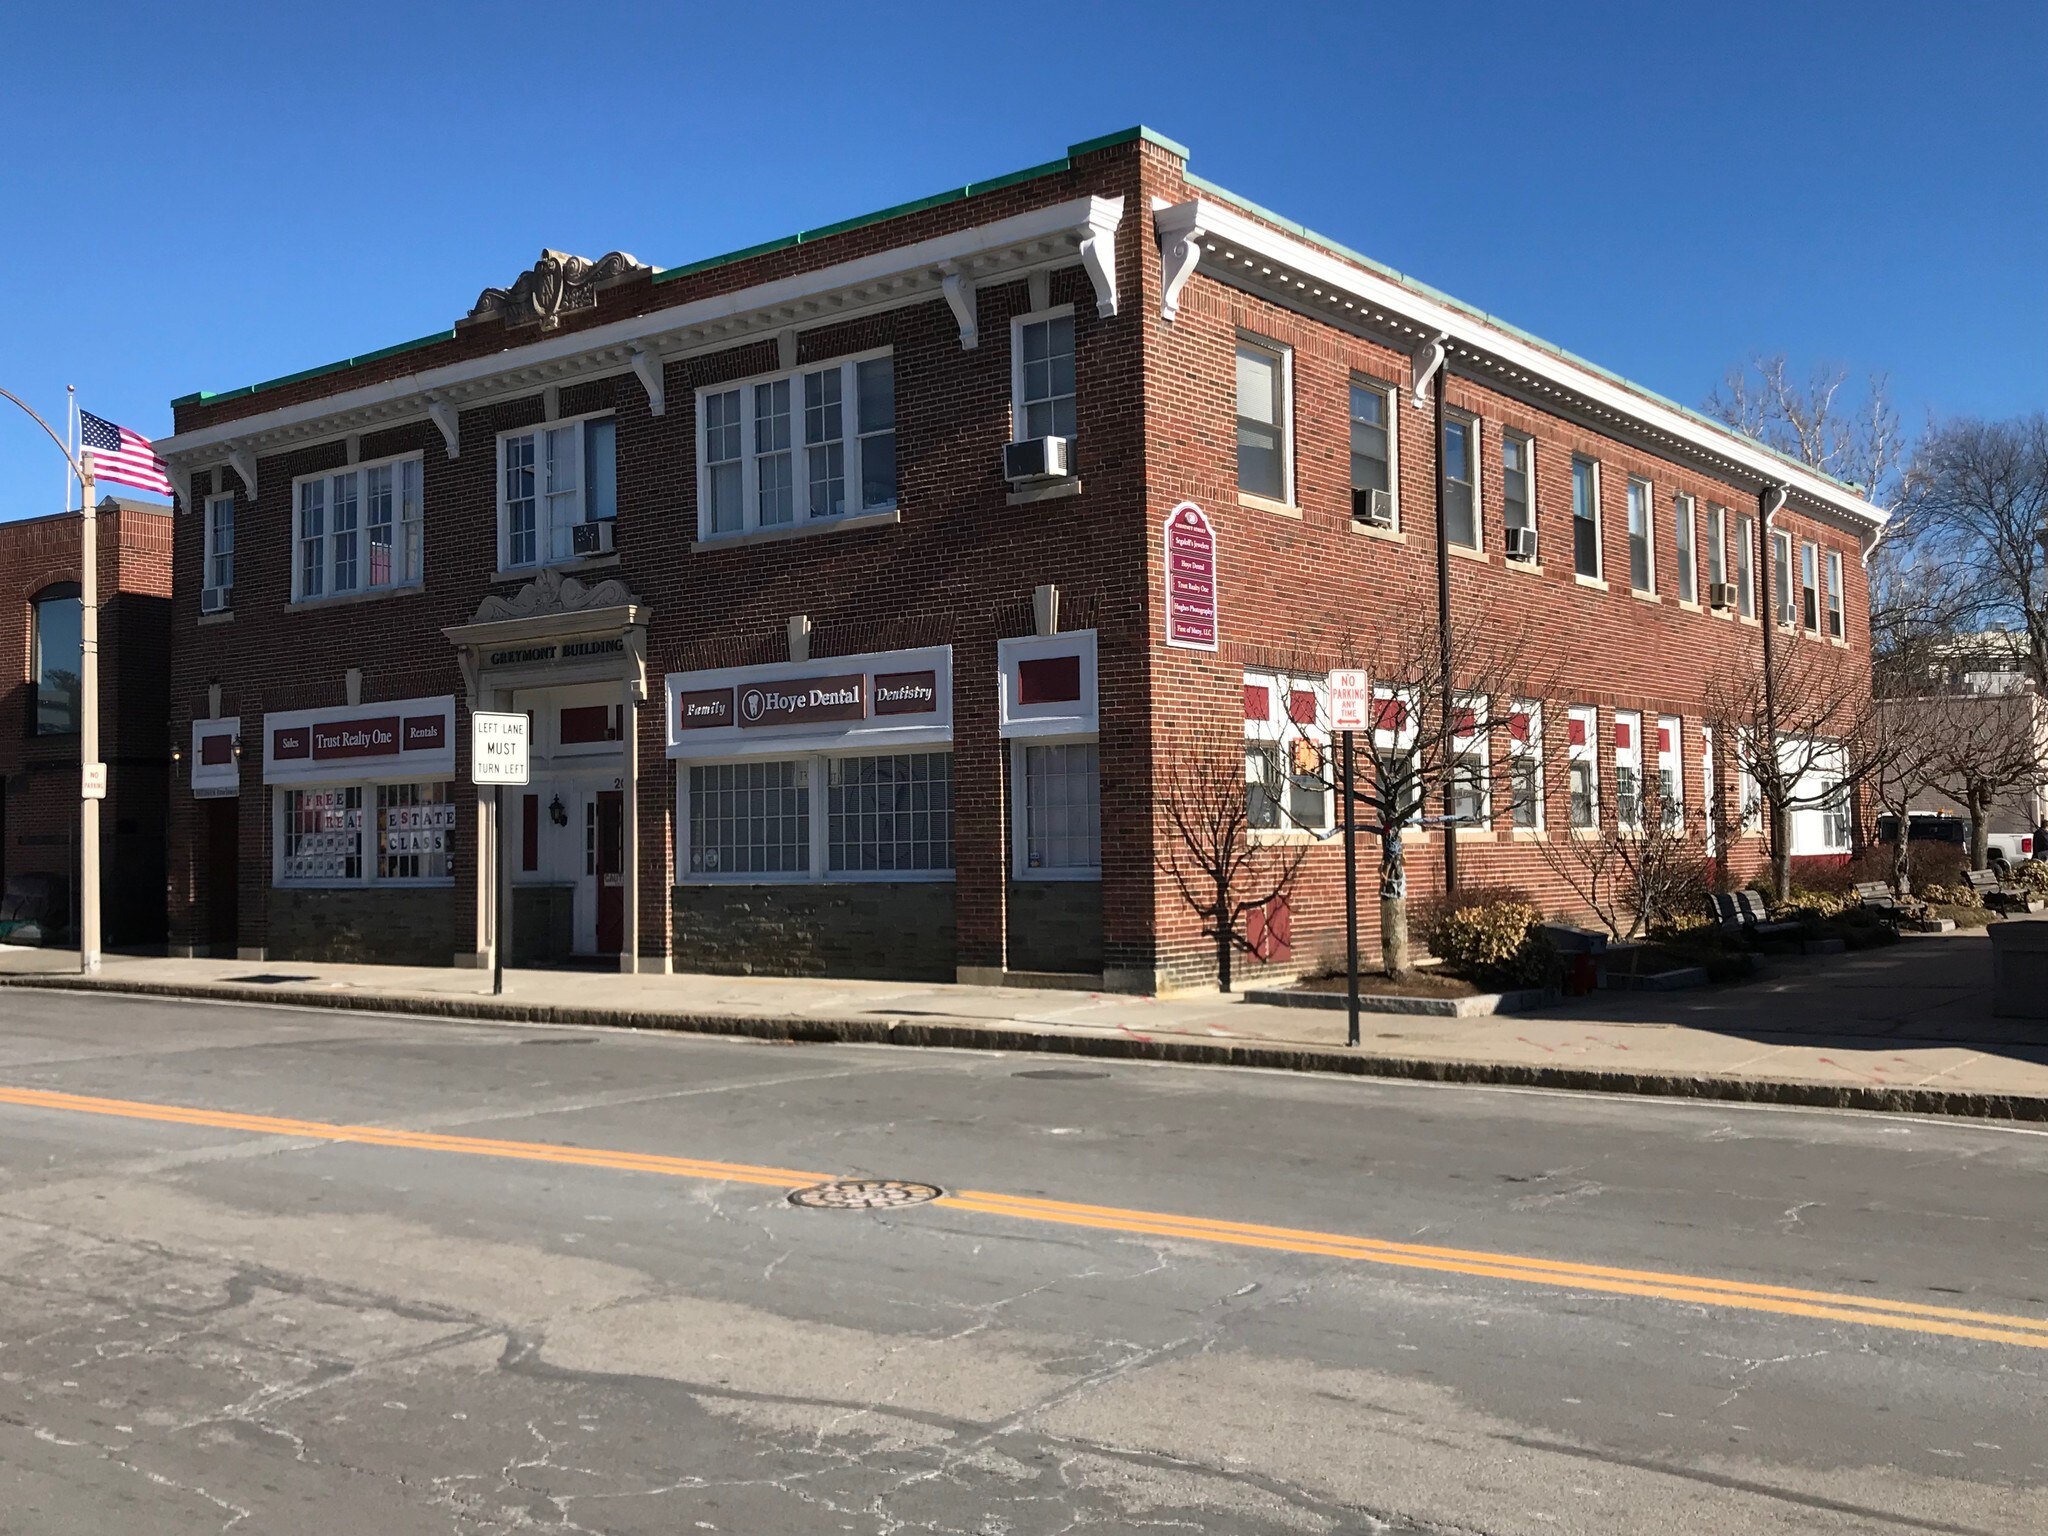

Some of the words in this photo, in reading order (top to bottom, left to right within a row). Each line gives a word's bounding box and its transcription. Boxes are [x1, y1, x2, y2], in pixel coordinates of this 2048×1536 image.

[1181, 560, 1191, 570] Hoye
[1192, 561, 1204, 571] Dental
[1178, 581, 1187, 590] Trust
[1188, 583, 1200, 593] Realty
[1200, 585, 1208, 593] One
[490, 646, 557, 665] GREYMONT
[562, 639, 624, 658] BUILDING
[1341, 675, 1355, 686] NO
[765, 692, 806, 713] Hoye
[809, 685, 859, 708] Dental
[876, 685, 932, 703] Dentistry
[1332, 689, 1364, 700] PARKING
[686, 701, 726, 717] Family
[410, 726, 438, 739] Rentals
[478, 722, 498, 733] LEFT
[503, 724, 524, 735] LANE
[282, 738, 299, 749] Sales
[316, 734, 341, 749] Trust
[342, 731, 370, 749] Realty
[372, 729, 392, 744] One
[487, 742, 516, 755] MUST
[478, 763, 500, 774] TURN
[504, 764, 524, 774] LEFT
[305, 793, 344, 807] FREE
[389, 811, 454, 827] ESTATE
[389, 837, 442, 850] CLASS
[604, 873, 624, 883] CAUT
